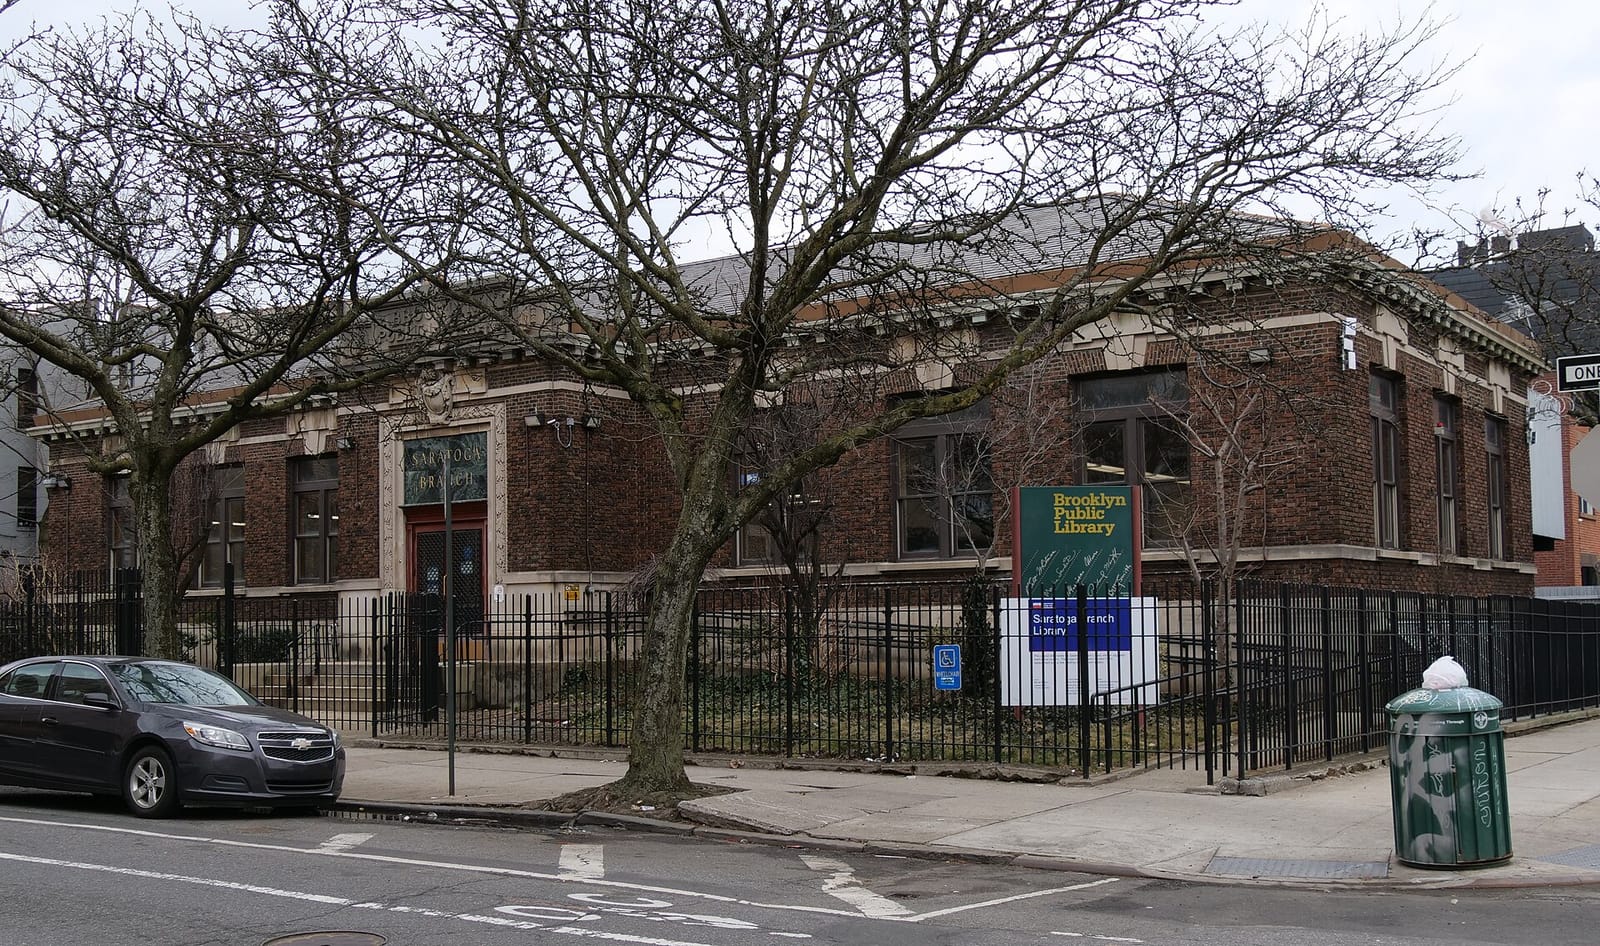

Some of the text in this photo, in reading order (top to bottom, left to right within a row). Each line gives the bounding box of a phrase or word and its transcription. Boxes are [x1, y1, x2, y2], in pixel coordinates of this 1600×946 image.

[411, 446, 481, 467] SARATOGA
[1053, 493, 1126, 509] Brooklyn
[1054, 506, 1105, 520] Public
[1053, 520, 1115, 536] Library
[1086, 614, 1115, 624] ranch
